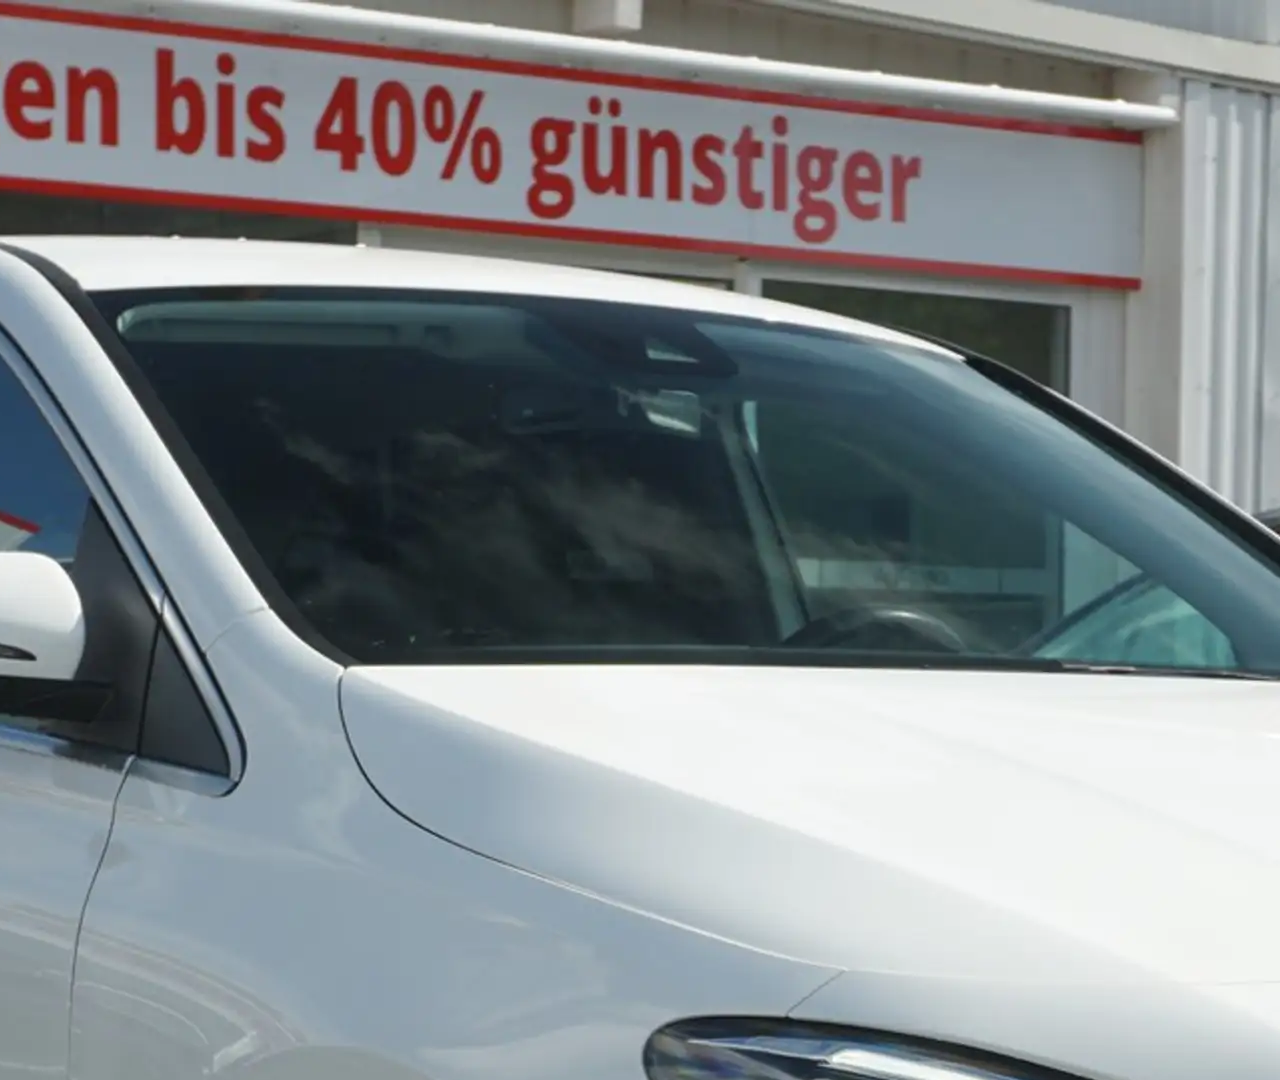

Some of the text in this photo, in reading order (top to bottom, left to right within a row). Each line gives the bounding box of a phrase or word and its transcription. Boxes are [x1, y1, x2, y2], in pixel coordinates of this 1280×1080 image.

[155, 49, 285, 162] bis
[315, 77, 502, 184] 40%
[526, 96, 920, 243] günstiger
